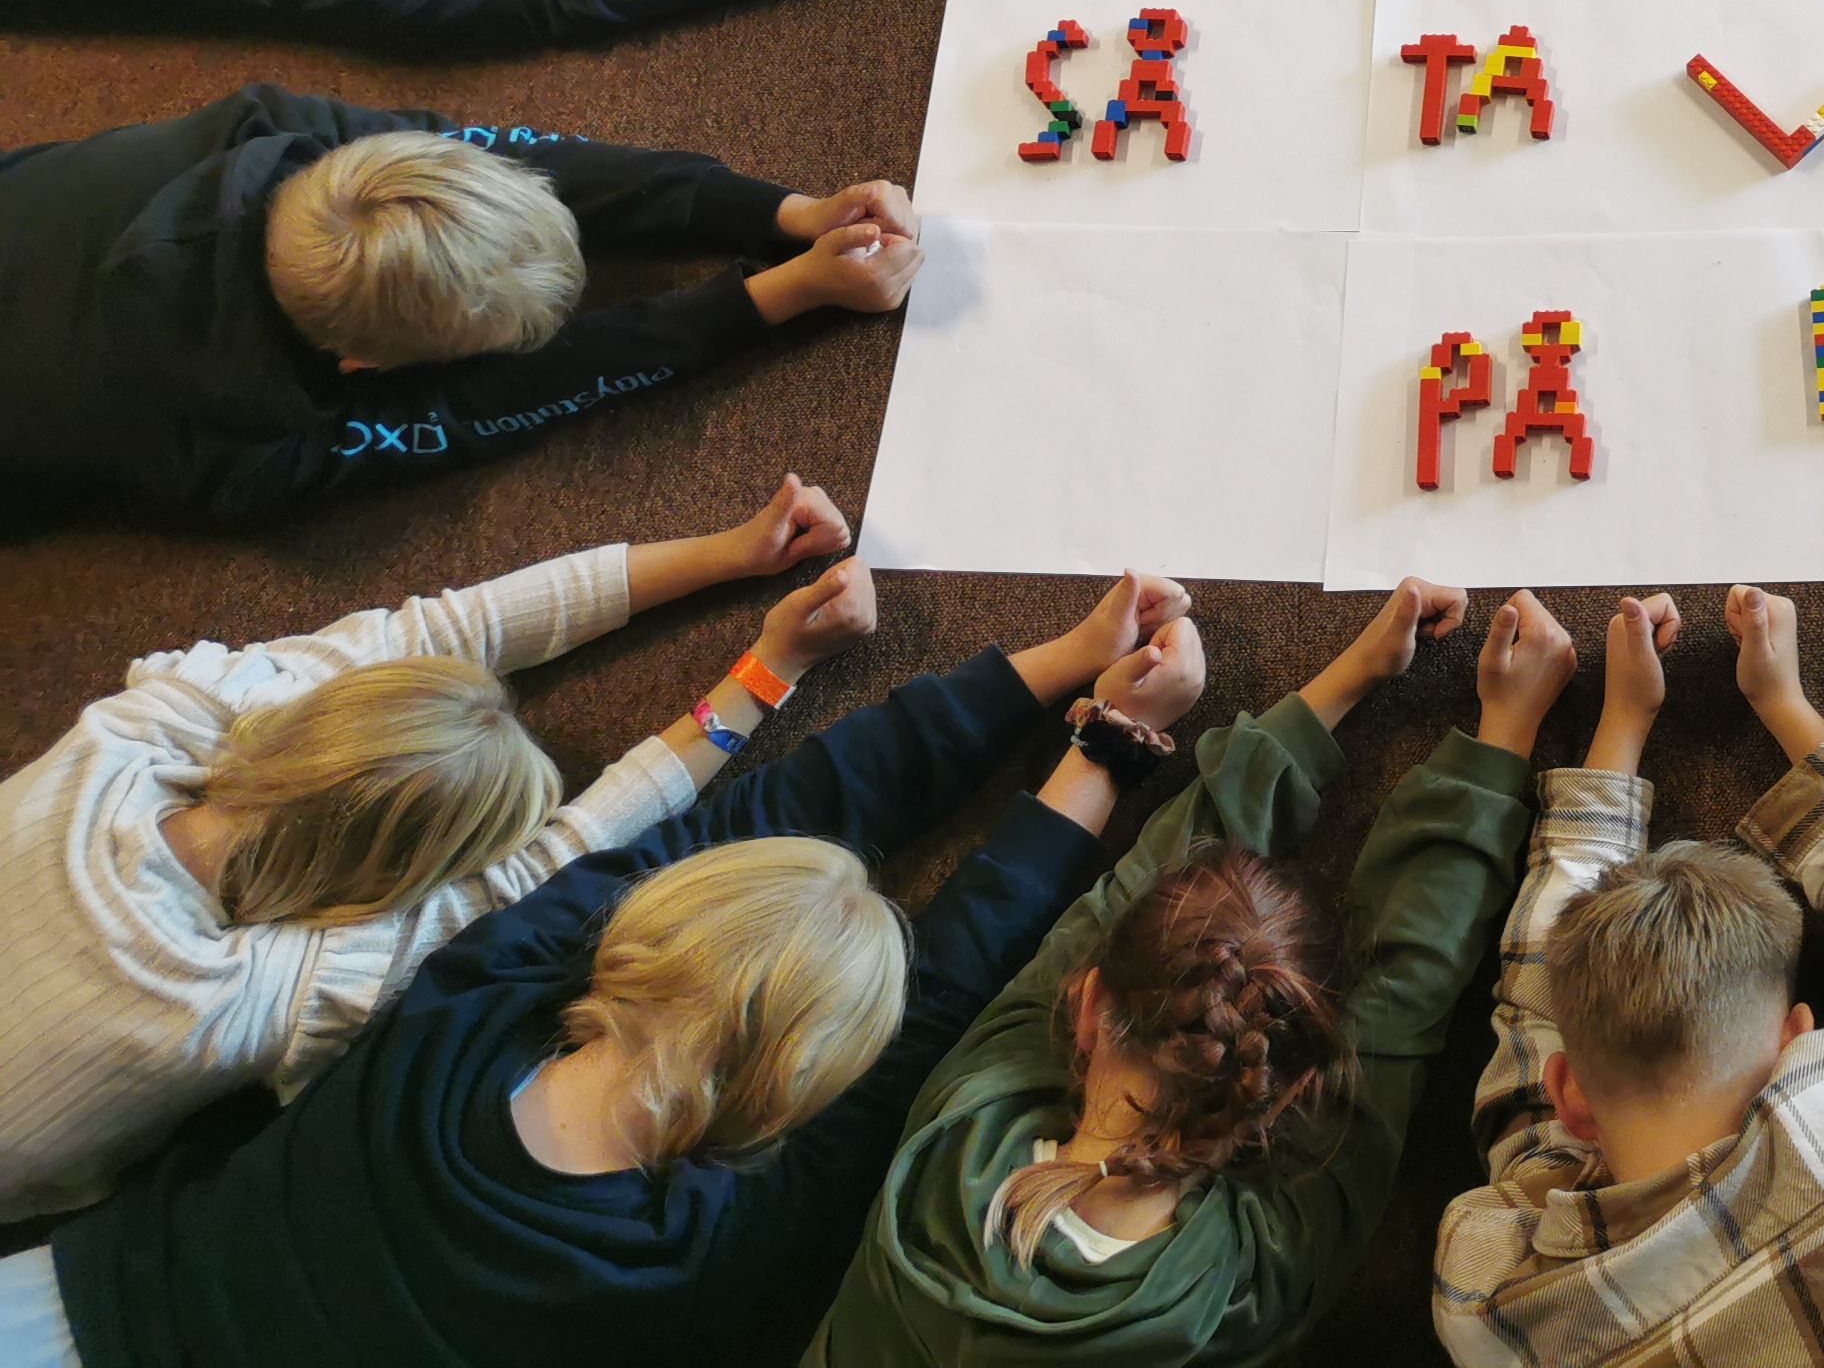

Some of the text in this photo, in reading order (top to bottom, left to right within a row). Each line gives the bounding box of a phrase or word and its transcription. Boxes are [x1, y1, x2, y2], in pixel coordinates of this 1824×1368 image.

[1018, 7, 1191, 162] SÅ
[1400, 25, 1554, 146] TA
[1417, 310, 1596, 492] PÅ
